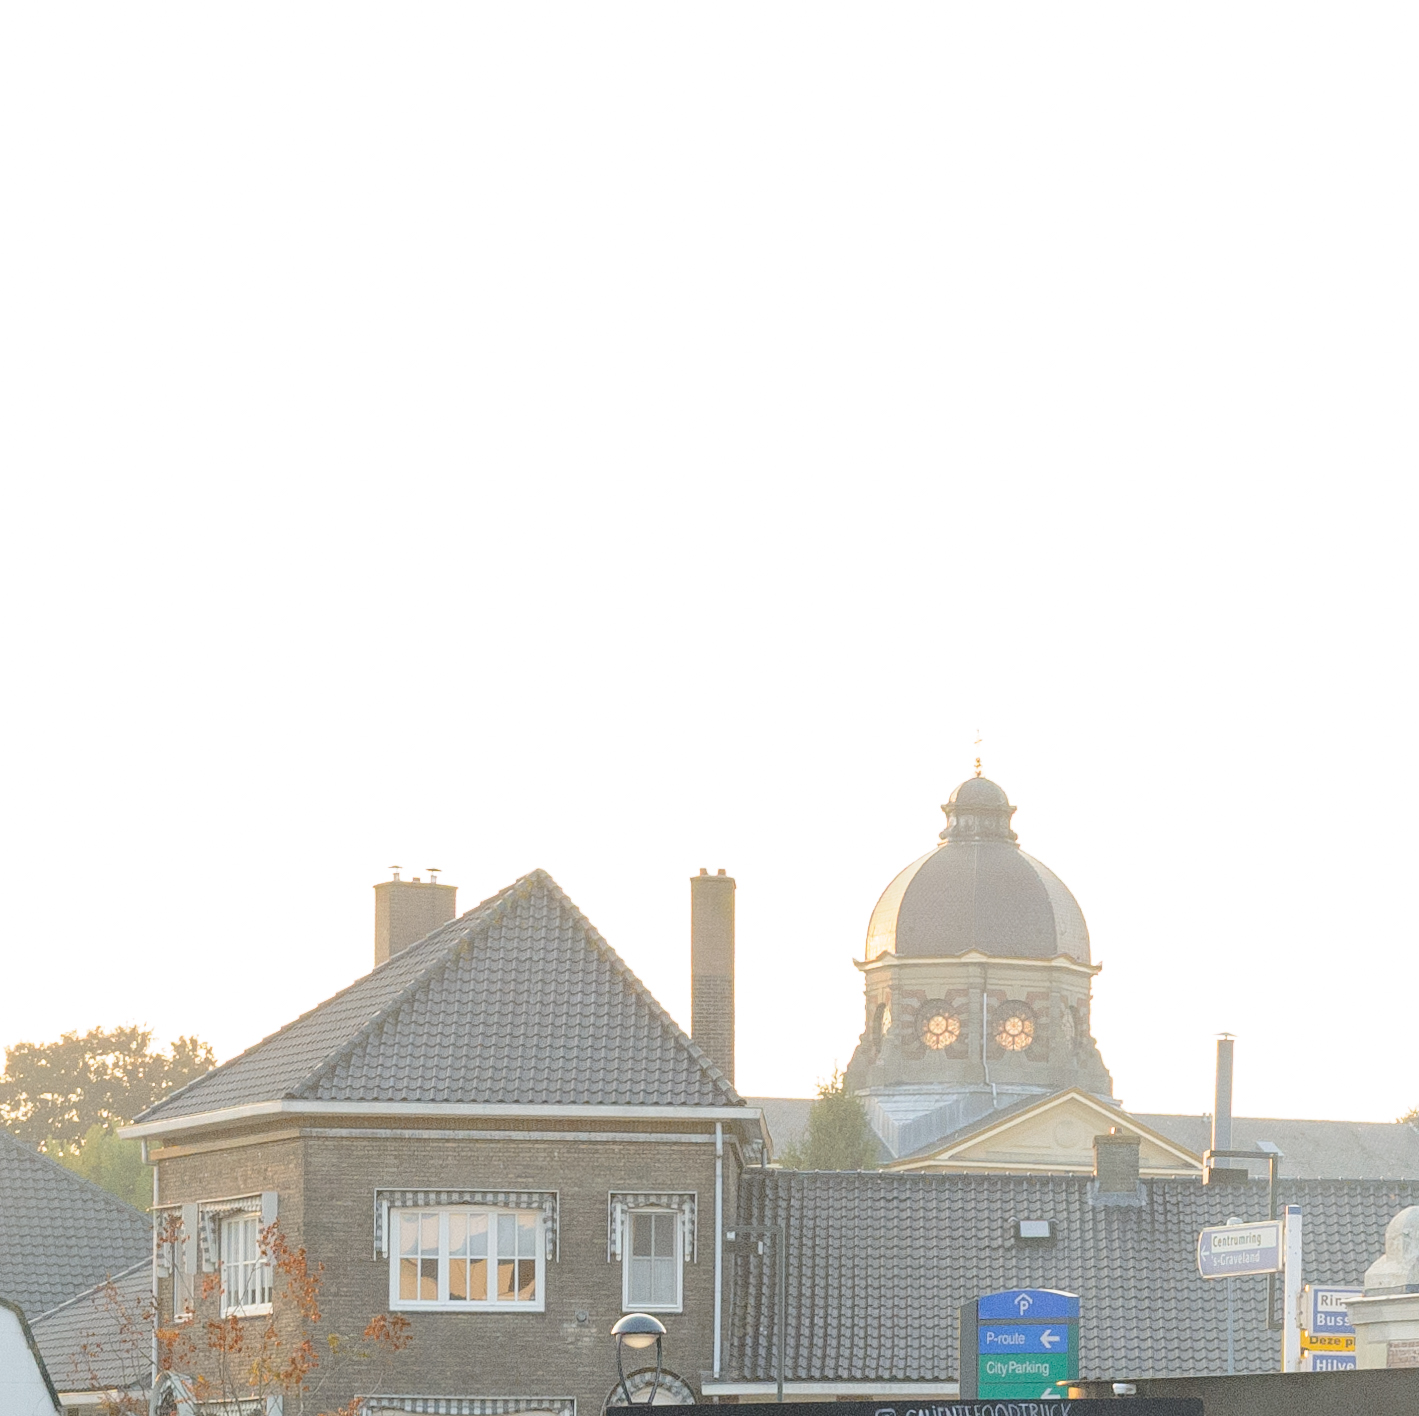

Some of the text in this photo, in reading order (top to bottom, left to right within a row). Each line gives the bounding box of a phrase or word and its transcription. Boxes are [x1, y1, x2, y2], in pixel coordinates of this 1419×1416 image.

[1212, 1232, 1262, 1248] Centrumring
[1211, 1250, 1260, 1267] 's-Graveland
[1020, 1300, 1029, 1316] P
[1320, 1294, 1346, 1309] Rin
[986, 1331, 1026, 1345] P-route
[1309, 1336, 1341, 1345] Deze
[986, 1361, 1050, 1377] City Parking
[1315, 1359, 1355, 1372] Hilve
